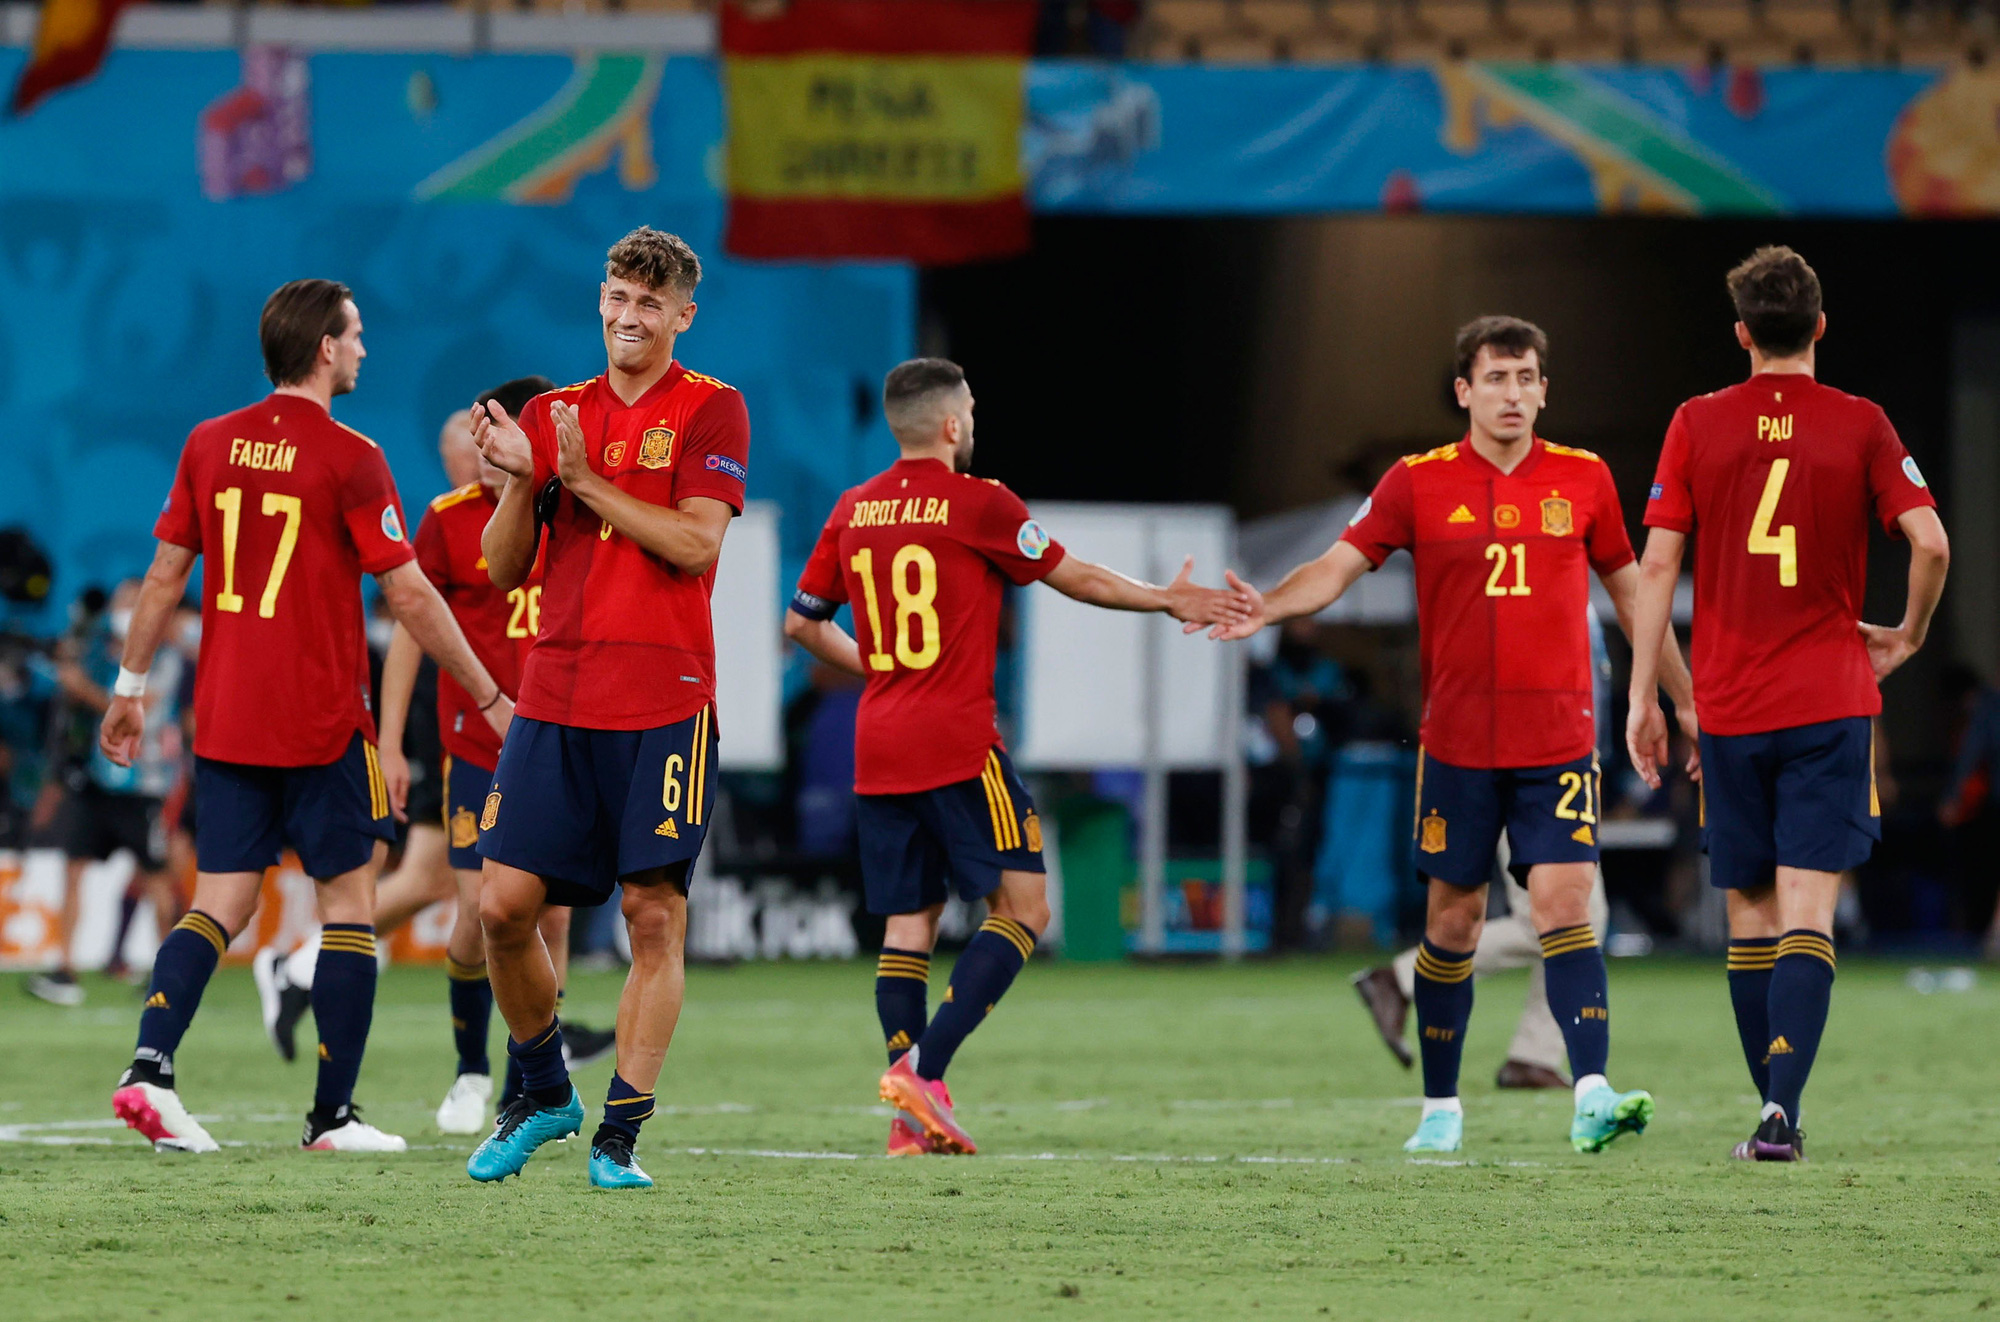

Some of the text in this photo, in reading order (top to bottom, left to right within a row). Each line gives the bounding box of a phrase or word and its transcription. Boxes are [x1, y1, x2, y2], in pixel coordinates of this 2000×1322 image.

[1757, 414, 1794, 442] PAU
[229, 438, 297, 472] FABIÁN
[720, 460, 746, 479] RESPECT
[849, 497, 949, 529] JORDI ALBA
[1747, 458, 1798, 587] 4
[215, 487, 302, 619] 17
[1485, 543, 1532, 597] 21
[850, 544, 941, 672] 18
[662, 753, 684, 812] 6
[1555, 772, 1596, 824] 21
[654, 828, 679, 840] adidas
